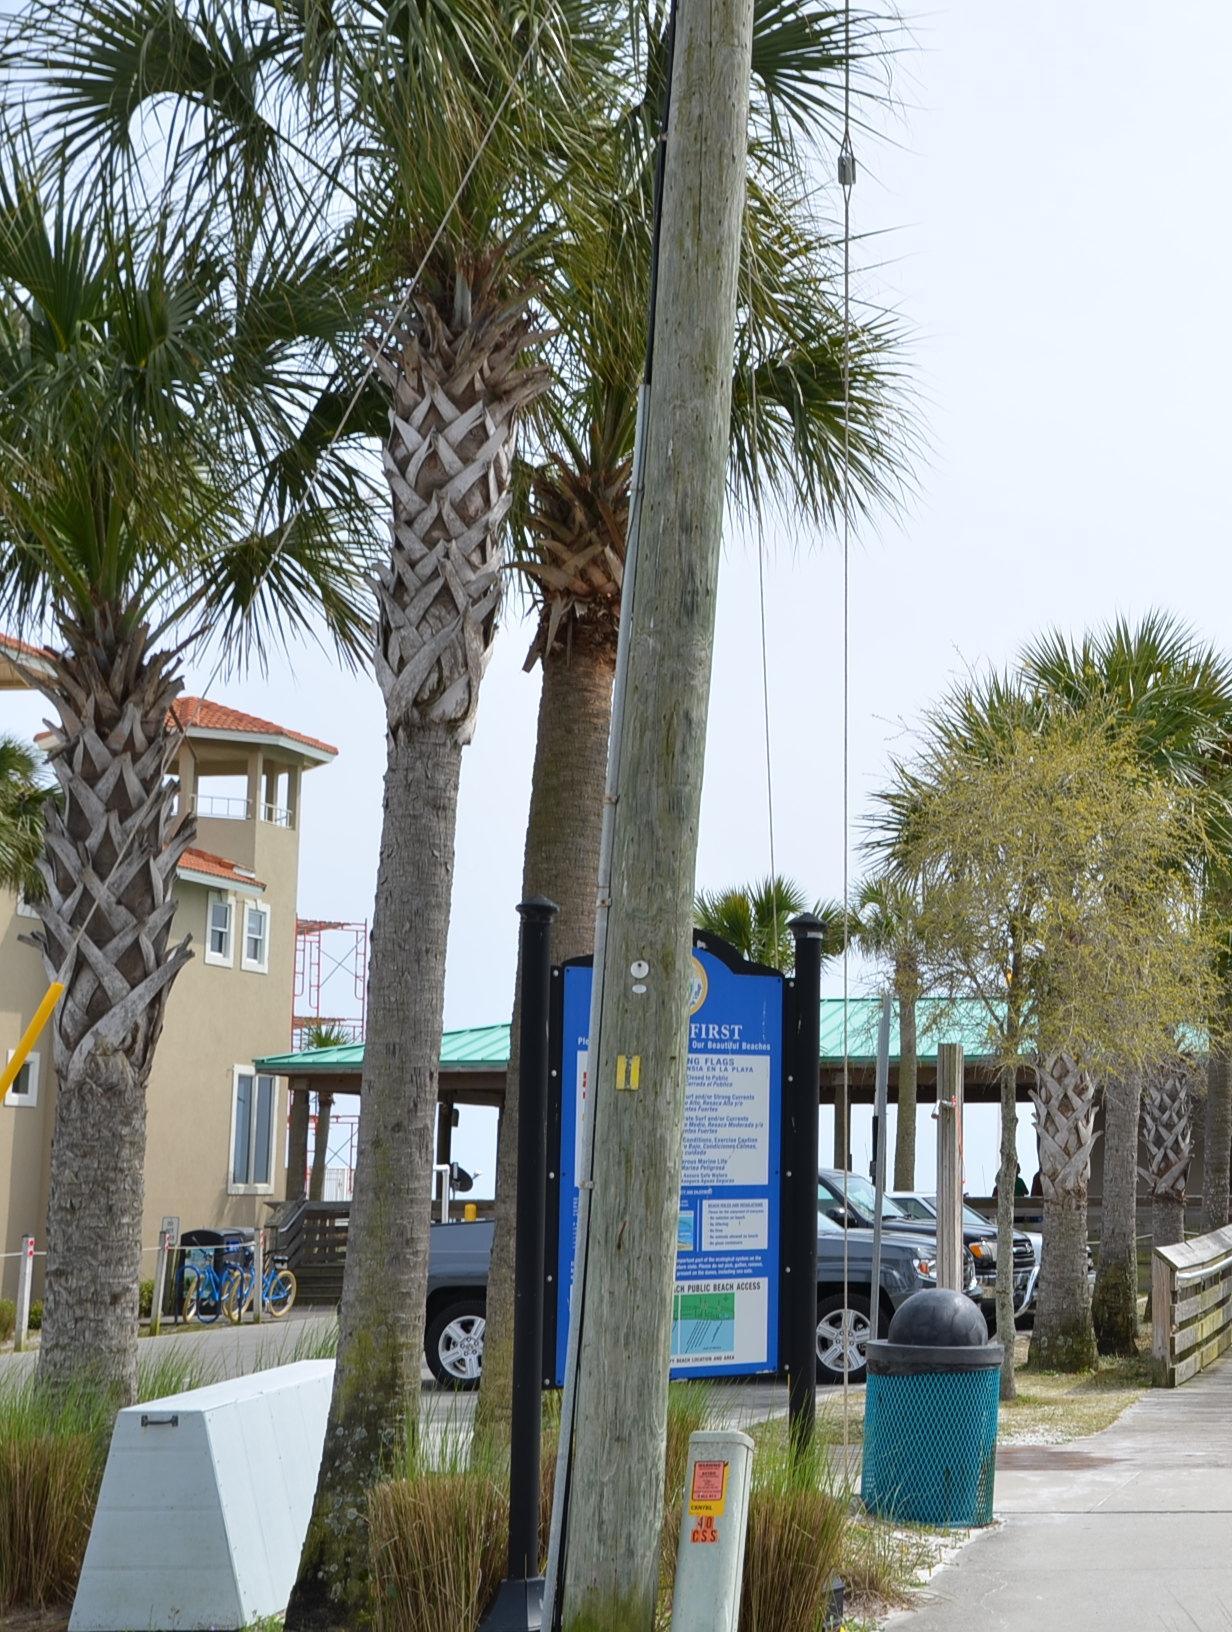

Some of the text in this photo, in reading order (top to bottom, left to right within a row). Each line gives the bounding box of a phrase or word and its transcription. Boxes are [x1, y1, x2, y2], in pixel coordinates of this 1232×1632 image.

[690, 1023, 742, 1040] FIRST
[692, 1040, 771, 1051] Our Beautiful Beaches
[705, 1057, 735, 1067] FLAGS
[687, 1284, 711, 1293] PUBLIC
[713, 1283, 734, 1291] BEACH
[736, 1281, 761, 1290] ACCESS
